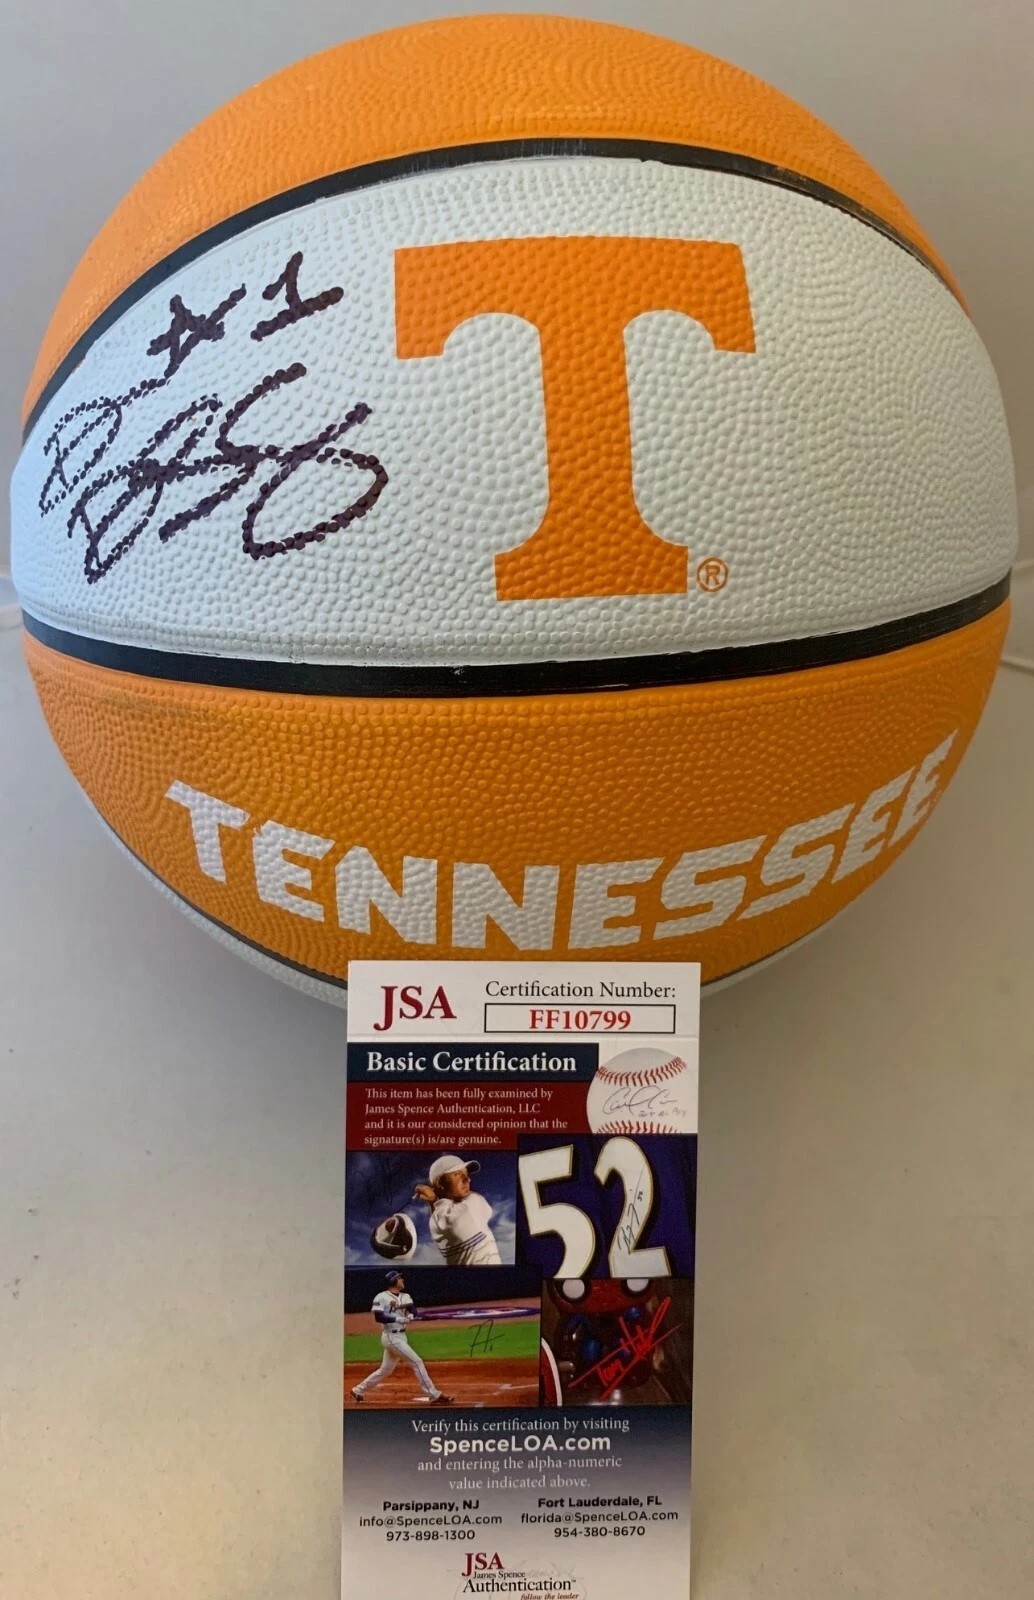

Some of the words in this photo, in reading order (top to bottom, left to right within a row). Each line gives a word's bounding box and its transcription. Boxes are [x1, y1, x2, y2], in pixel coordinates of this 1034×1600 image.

[394, 236, 756, 600] T
[165, 730, 957, 951] TENNESSEE
[485, 981, 593, 997] Certification
[600, 982, 676, 998] Number:
[374, 986, 456, 1031] JSA
[529, 1009, 631, 1030] FF10799
[367, 1052, 426, 1072] Basic
[433, 1052, 576, 1072] Certification
[365, 1088, 387, 1099] This
[389, 1089, 413, 1099] item
[416, 1088, 433, 1099] has
[436, 1088, 461, 1099] been
[463, 1088, 484, 1101] fully
[487, 1088, 538, 1099] examined
[541, 1088, 553, 1101] by
[365, 1104, 395, 1115] James
[398, 1104, 434, 1116] Spence
[437, 1103, 515, 1115] Authentication,
[519, 1104, 540, 1113] LLC
[365, 1119, 383, 1129] and
[386, 1119, 393, 1129] it
[396, 1119, 405, 1129] is
[408, 1121, 426, 1129] our
[429, 1119, 484, 1129] considered
[487, 1119, 526, 1131] opinion
[529, 1119, 549, 1129] that
[552, 1119, 568, 1129] the
[364, 1134, 425, 1147] signature(s)
[428, 1134, 455, 1145] is/are
[458, 1135, 502, 1147] genuine.
[412, 1420, 451, 1434] Verify
[455, 1420, 479, 1431] this
[483, 1419, 560, 1431] certification
[563, 1418, 578, 1432] by
[583, 1418, 630, 1432] visiting
[430, 1435, 610, 1455] SpenceLOA.com
[417, 1459, 442, 1470] and
[446, 1458, 500, 1473] entering
[504, 1457, 524, 1469] the
[527, 1456, 623, 1470] alpha-numeric
[449, 1478, 483, 1489] value
[487, 1476, 546, 1489] indicated
[550, 1476, 591, 1488] above.
[383, 1501, 459, 1513] Parsippany,
[463, 1501, 479, 1510] NJ
[538, 1498, 565, 1508] Fort
[569, 1497, 643, 1508] Lauderdale,
[647, 1496, 662, 1505] FL
[360, 1514, 502, 1527] info@SpenceLOA.com
[521, 1510, 678, 1524] florida@SpenceLOA.com
[386, 1530, 475, 1541] 973-898-1300
[554, 1527, 645, 1537] 954-380-8670
[462, 1553, 504, 1576] JSA
[473, 1571, 495, 1580] James
[498, 1571, 525, 1579] Spence
